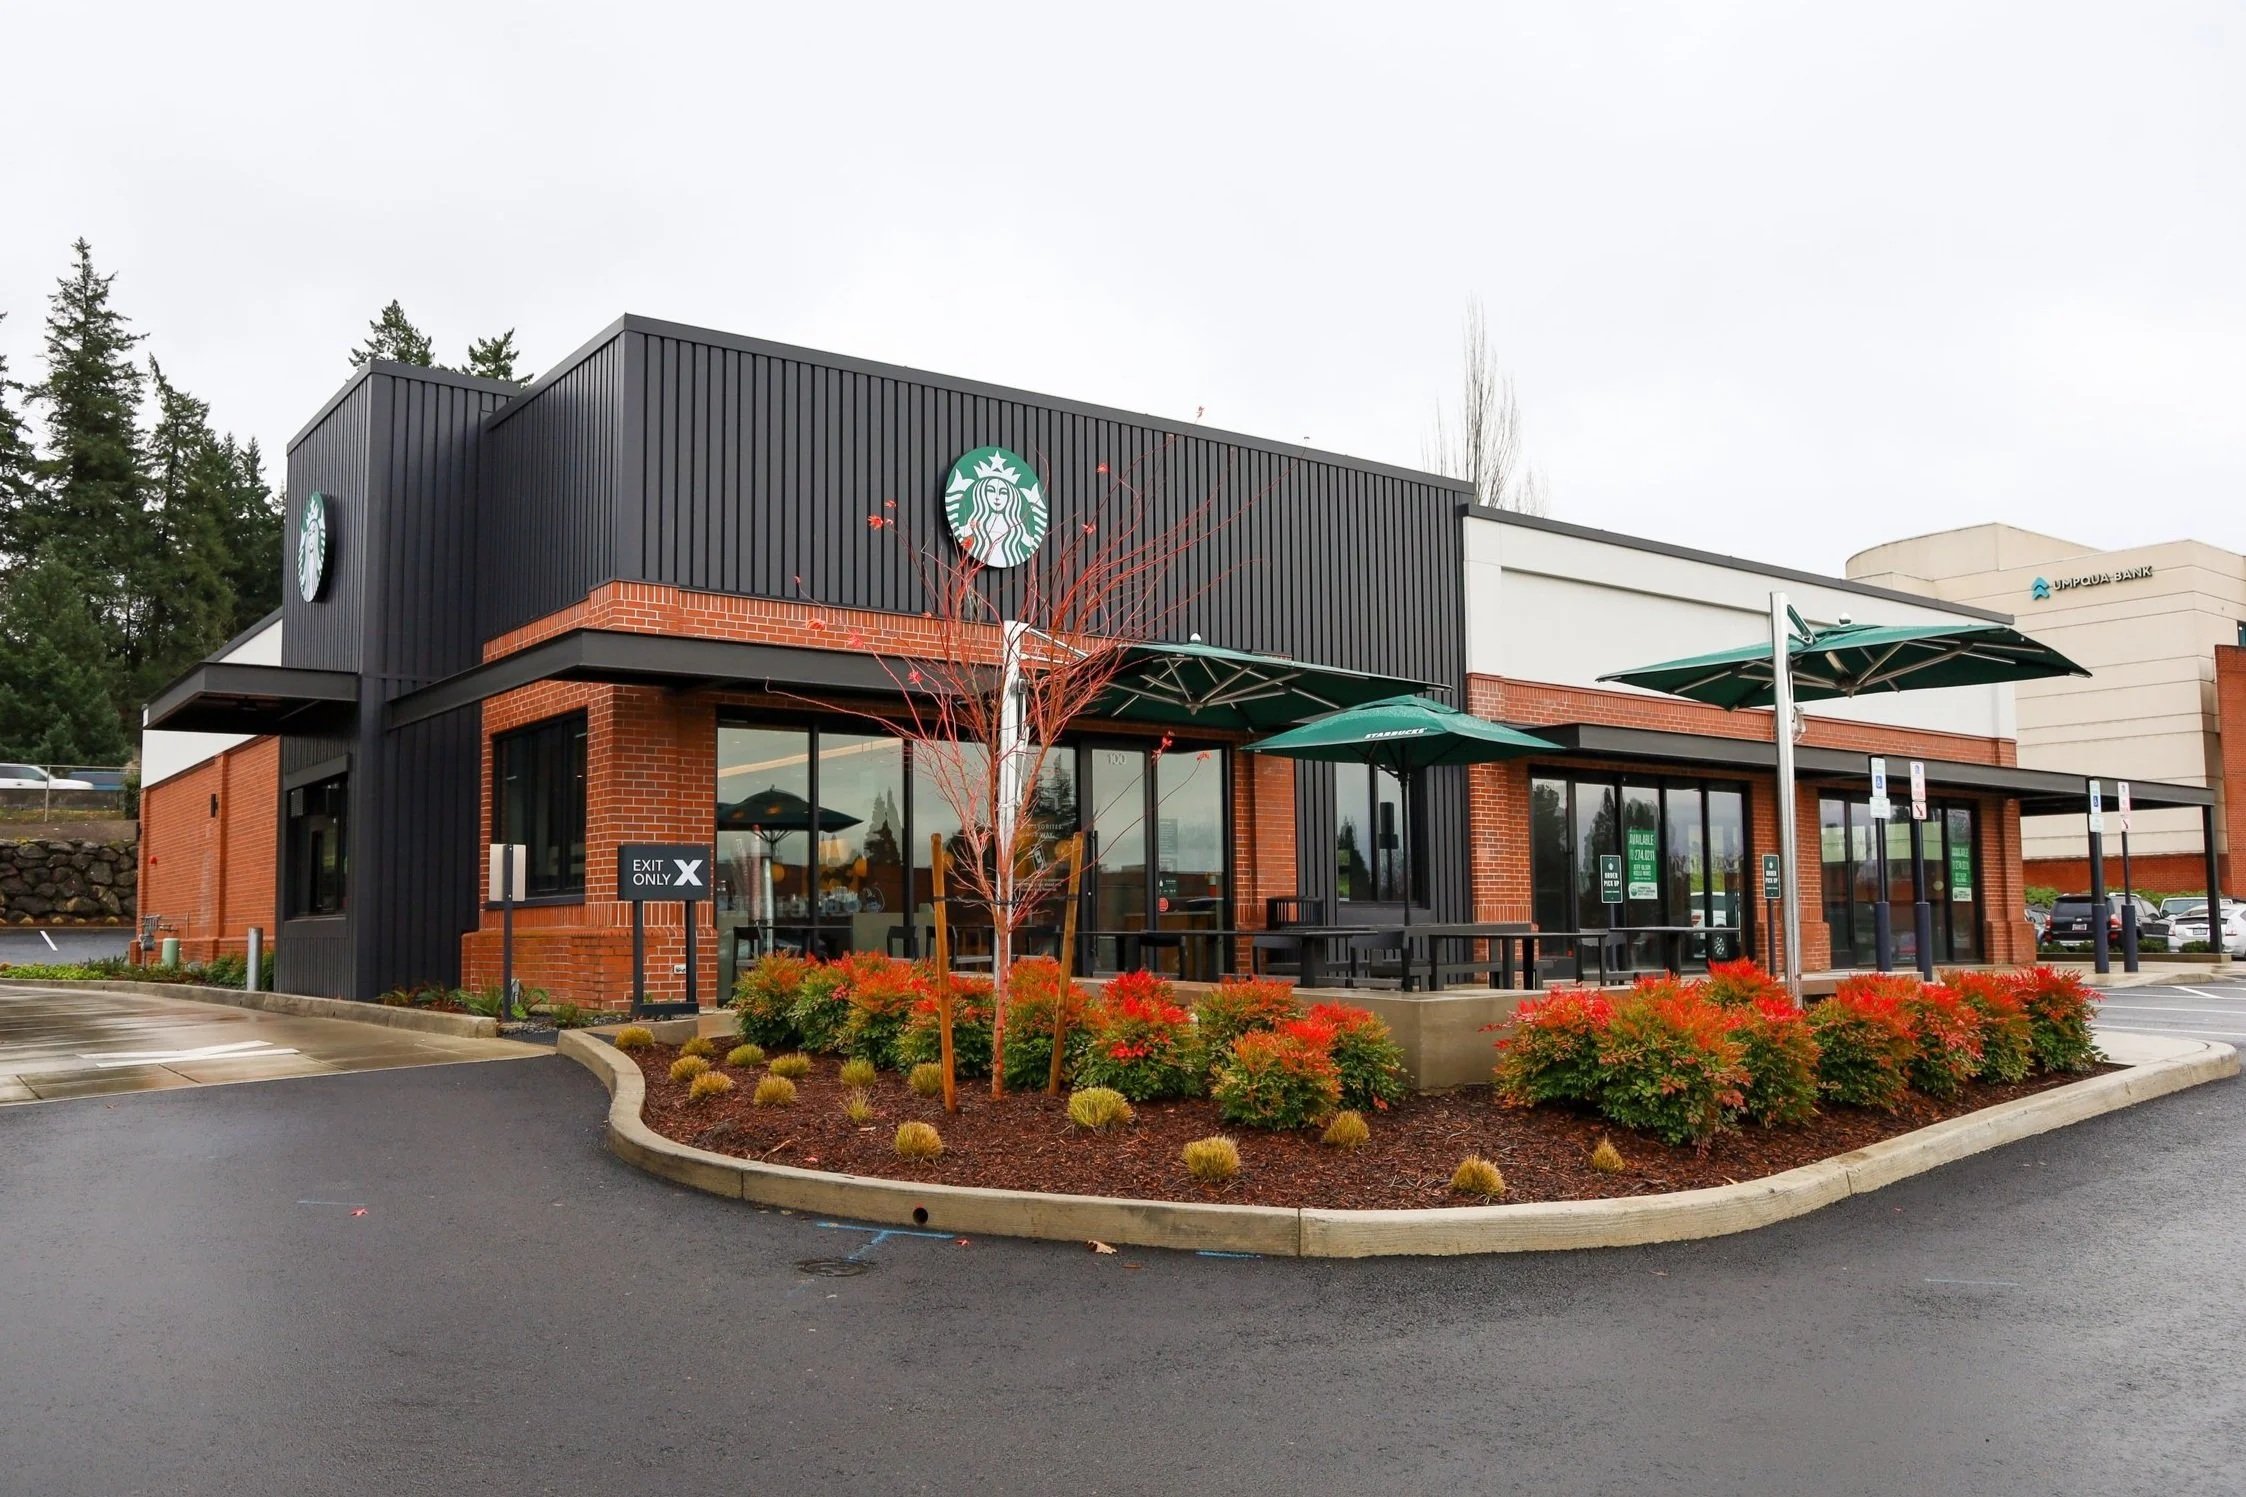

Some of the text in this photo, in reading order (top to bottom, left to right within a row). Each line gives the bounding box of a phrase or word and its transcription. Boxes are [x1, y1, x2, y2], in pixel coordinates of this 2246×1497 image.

[2053, 566, 2152, 591] UMPQUA BANK
[1364, 728, 1425, 739] STARBUCKS
[1630, 834, 1654, 845] AVAILABLE
[633, 859, 664, 872] EXIT
[632, 873, 671, 886] ONLY
